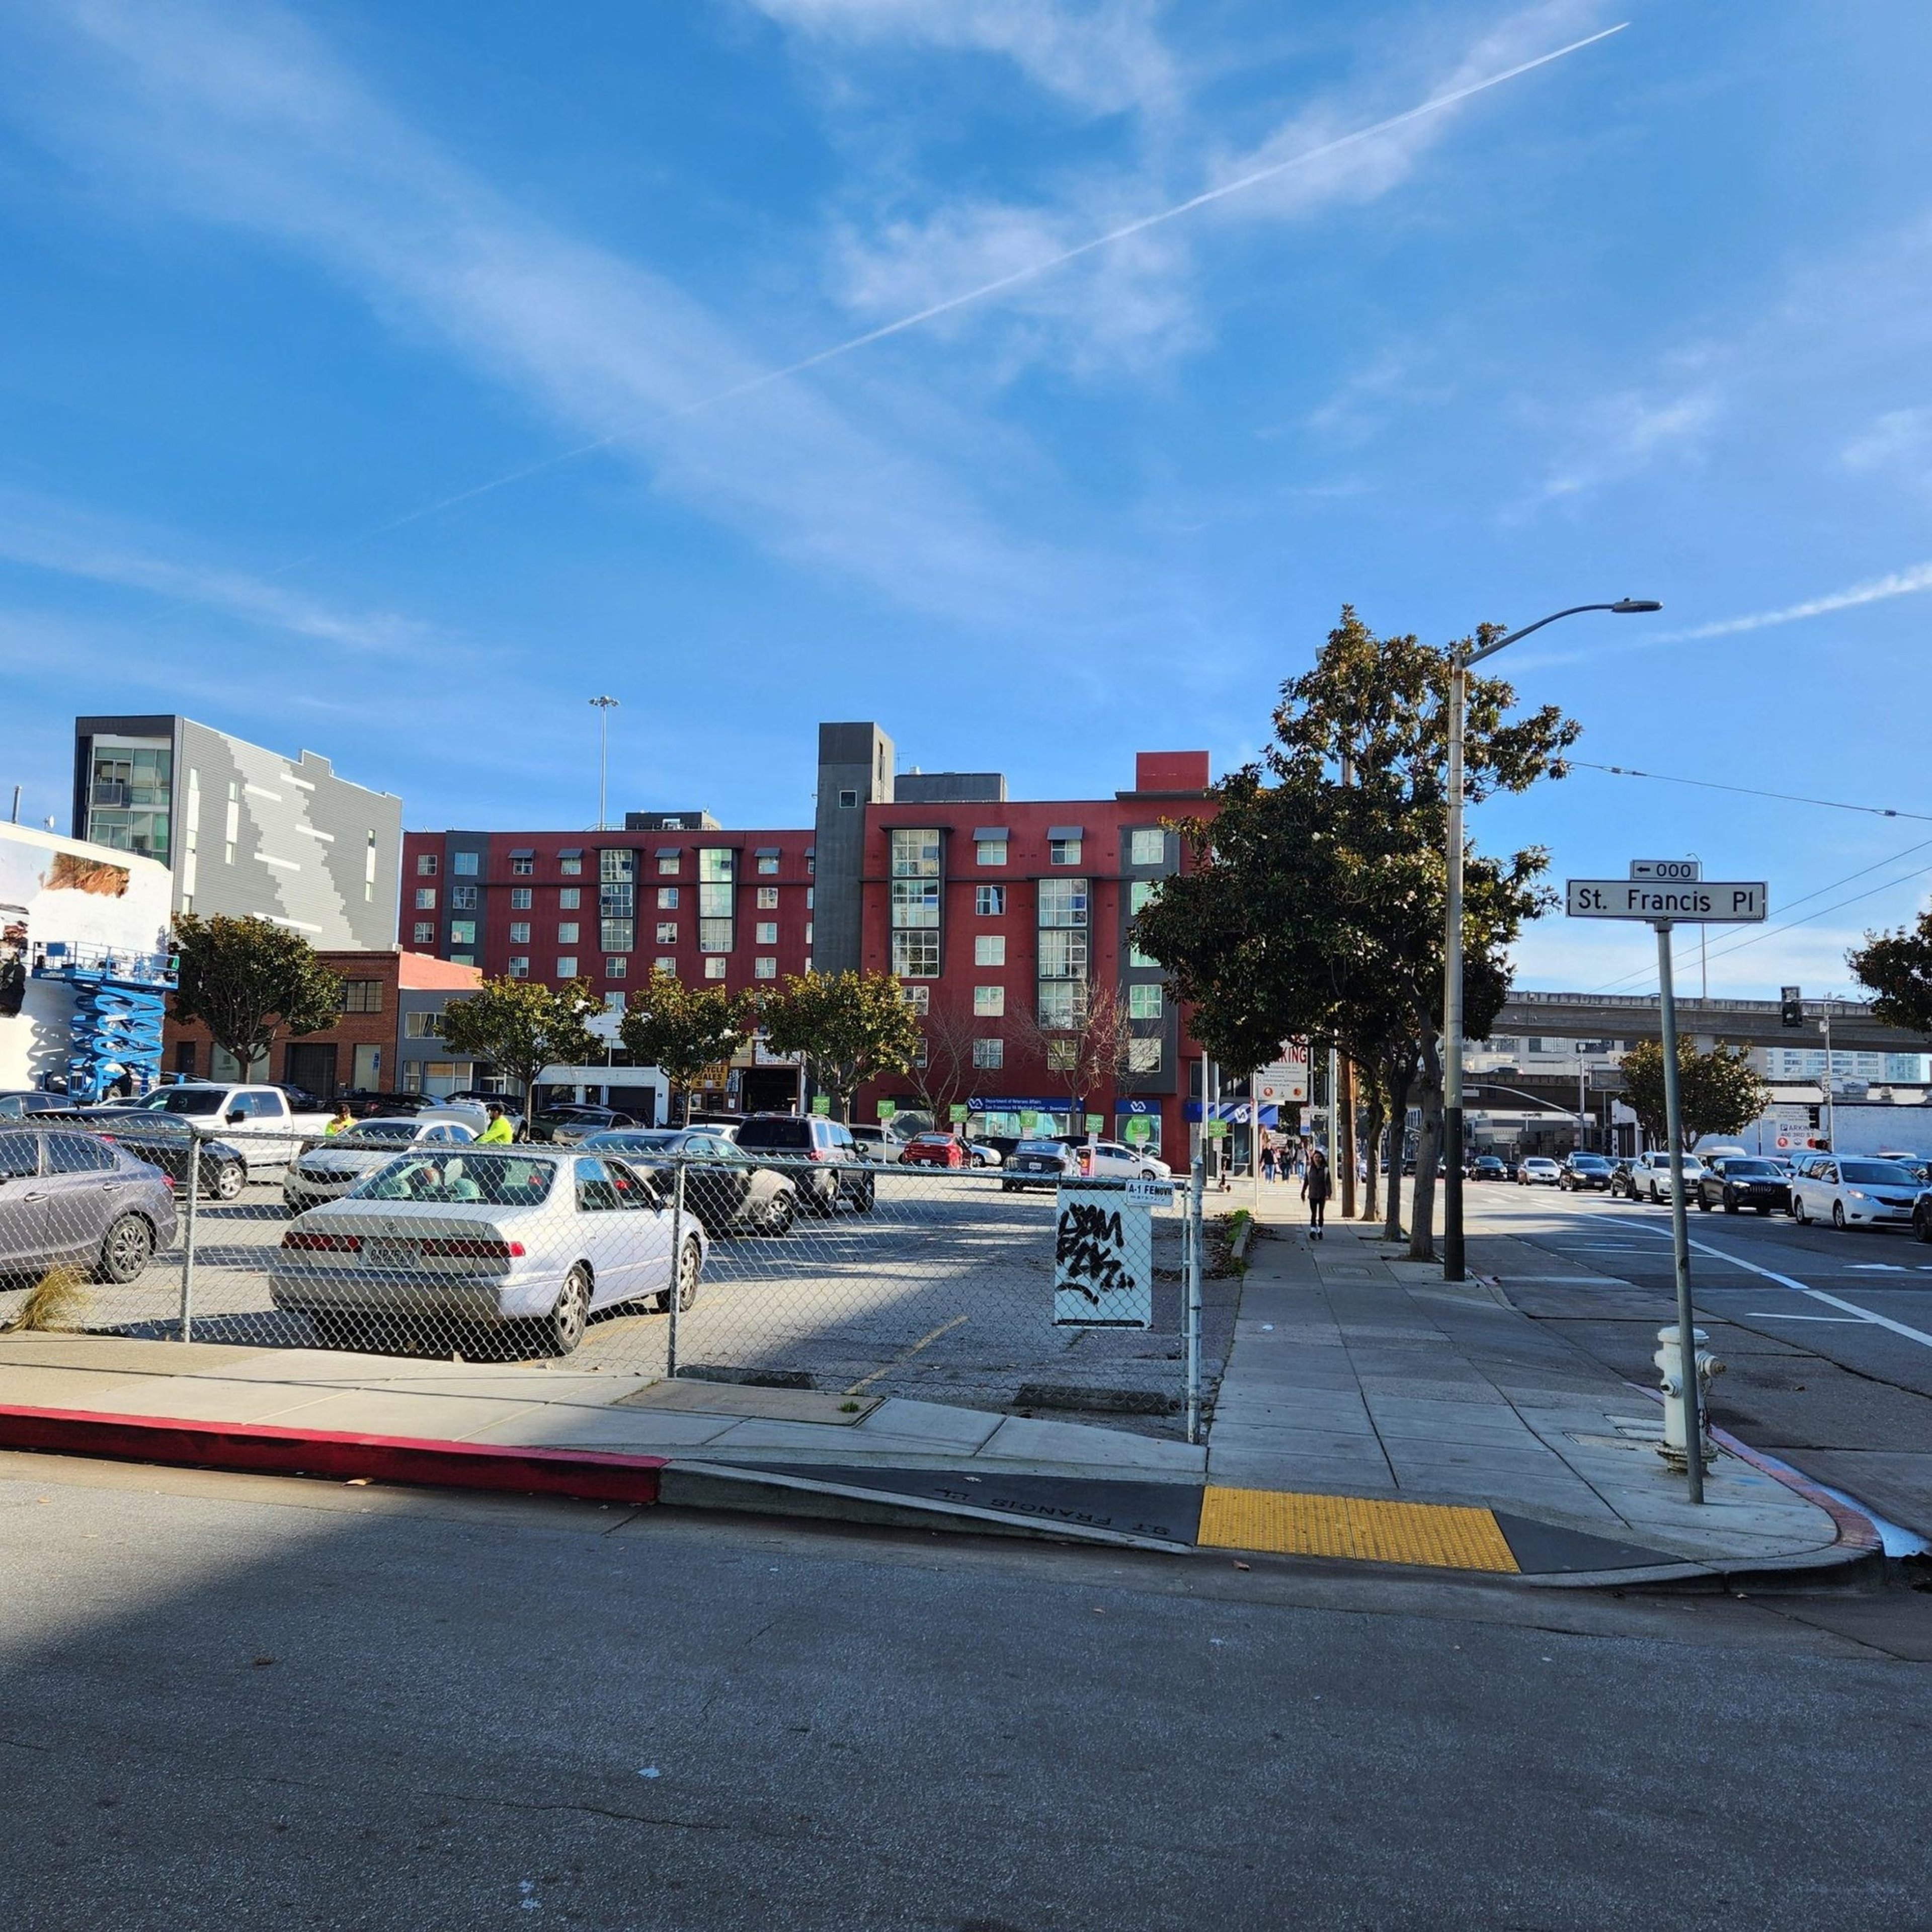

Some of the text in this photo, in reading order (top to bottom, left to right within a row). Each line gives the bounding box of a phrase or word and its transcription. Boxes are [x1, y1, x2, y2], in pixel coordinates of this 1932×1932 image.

[1656, 863, 1691, 877] 000
[1578, 888, 1753, 912] St. Francis Pl
[1823, 1084, 1830, 1093] 25
[1129, 1184, 1141, 1194] A-1
[990, 1498, 1110, 1526] FRANCIS
